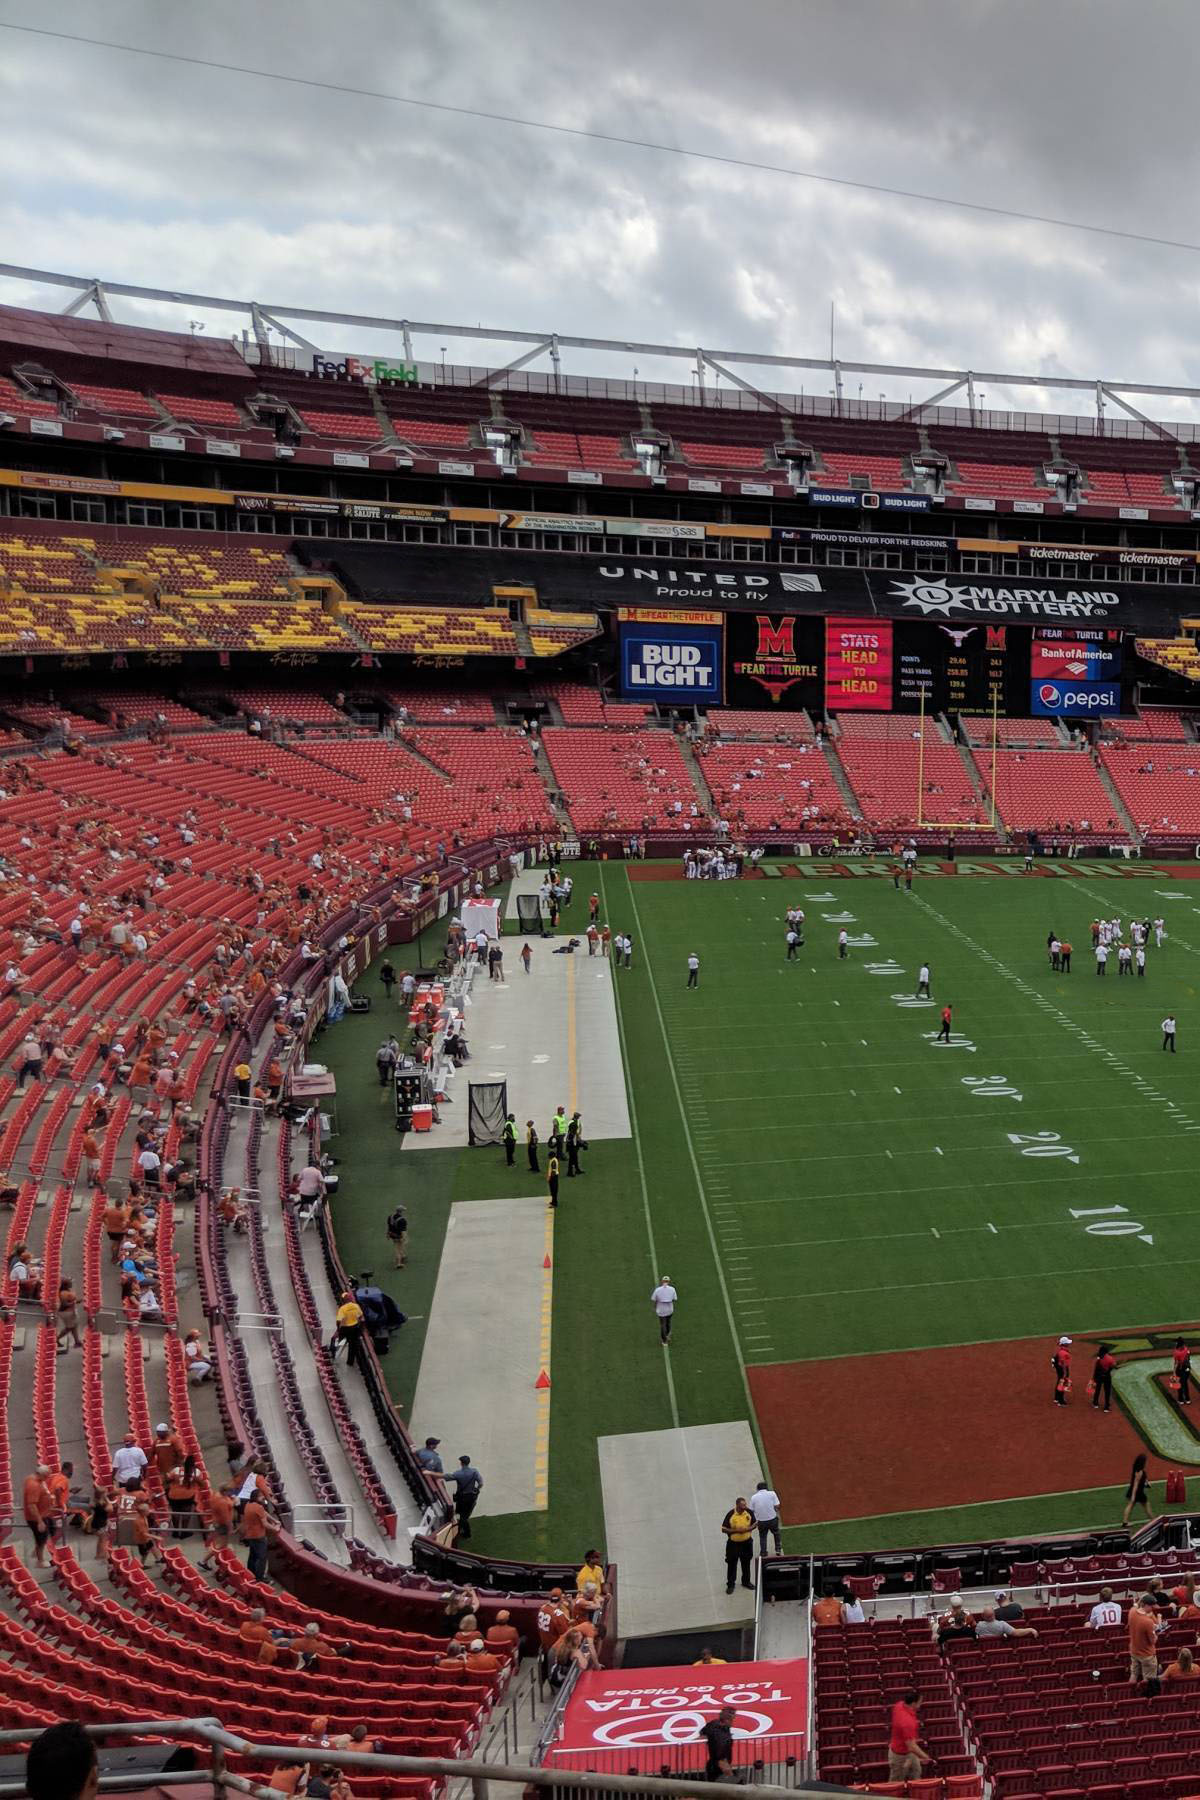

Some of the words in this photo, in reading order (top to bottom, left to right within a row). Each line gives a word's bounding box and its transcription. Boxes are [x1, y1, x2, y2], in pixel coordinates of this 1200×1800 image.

[312, 354, 419, 383] FedExField
[813, 494, 831, 502] BUD
[831, 495, 857, 504] LIGHT
[884, 498, 902, 507] BUD
[902, 500, 928, 508] LIGHT
[353, 510, 381, 519] SALUTE
[811, 533, 837, 542] PROUD
[838, 534, 848, 543] TO
[849, 535, 880, 544] DELIVER
[880, 537, 895, 545] FOR
[895, 538, 910, 546] THE
[1030, 547, 1095, 561] ticketmaster
[1119, 552, 1184, 566] ticketmaster
[599, 566, 770, 586] UNITED
[656, 586, 713, 597] Proud
[720, 590, 739, 599] to
[745, 591, 769, 601] fly
[968, 586, 1120, 605] MARYLAND
[972, 599, 1095, 617] LOTTERY
[840, 633, 879, 648] STATS
[642, 644, 702, 666] BUD
[840, 651, 878, 664] HEAD
[1041, 647, 1066, 658] Bank
[1065, 648, 1075, 658] of
[1075, 649, 1114, 660] America
[630, 664, 713, 686] LIGHT
[853, 667, 866, 677] TO
[840, 680, 878, 694] HEAD
[1064, 690, 1115, 709] pepsi
[960, 1075, 1019, 1096] 30
[1006, 1131, 1075, 1158] 20
[1068, 1203, 1146, 1237] 10
[1101, 1609, 1118, 1624] 10
[603, 1686, 680, 1697] Places
[682, 1682, 717, 1695] Go
[719, 1680, 774, 1692] Let's
[585, 1690, 792, 1712] TOYOTA
